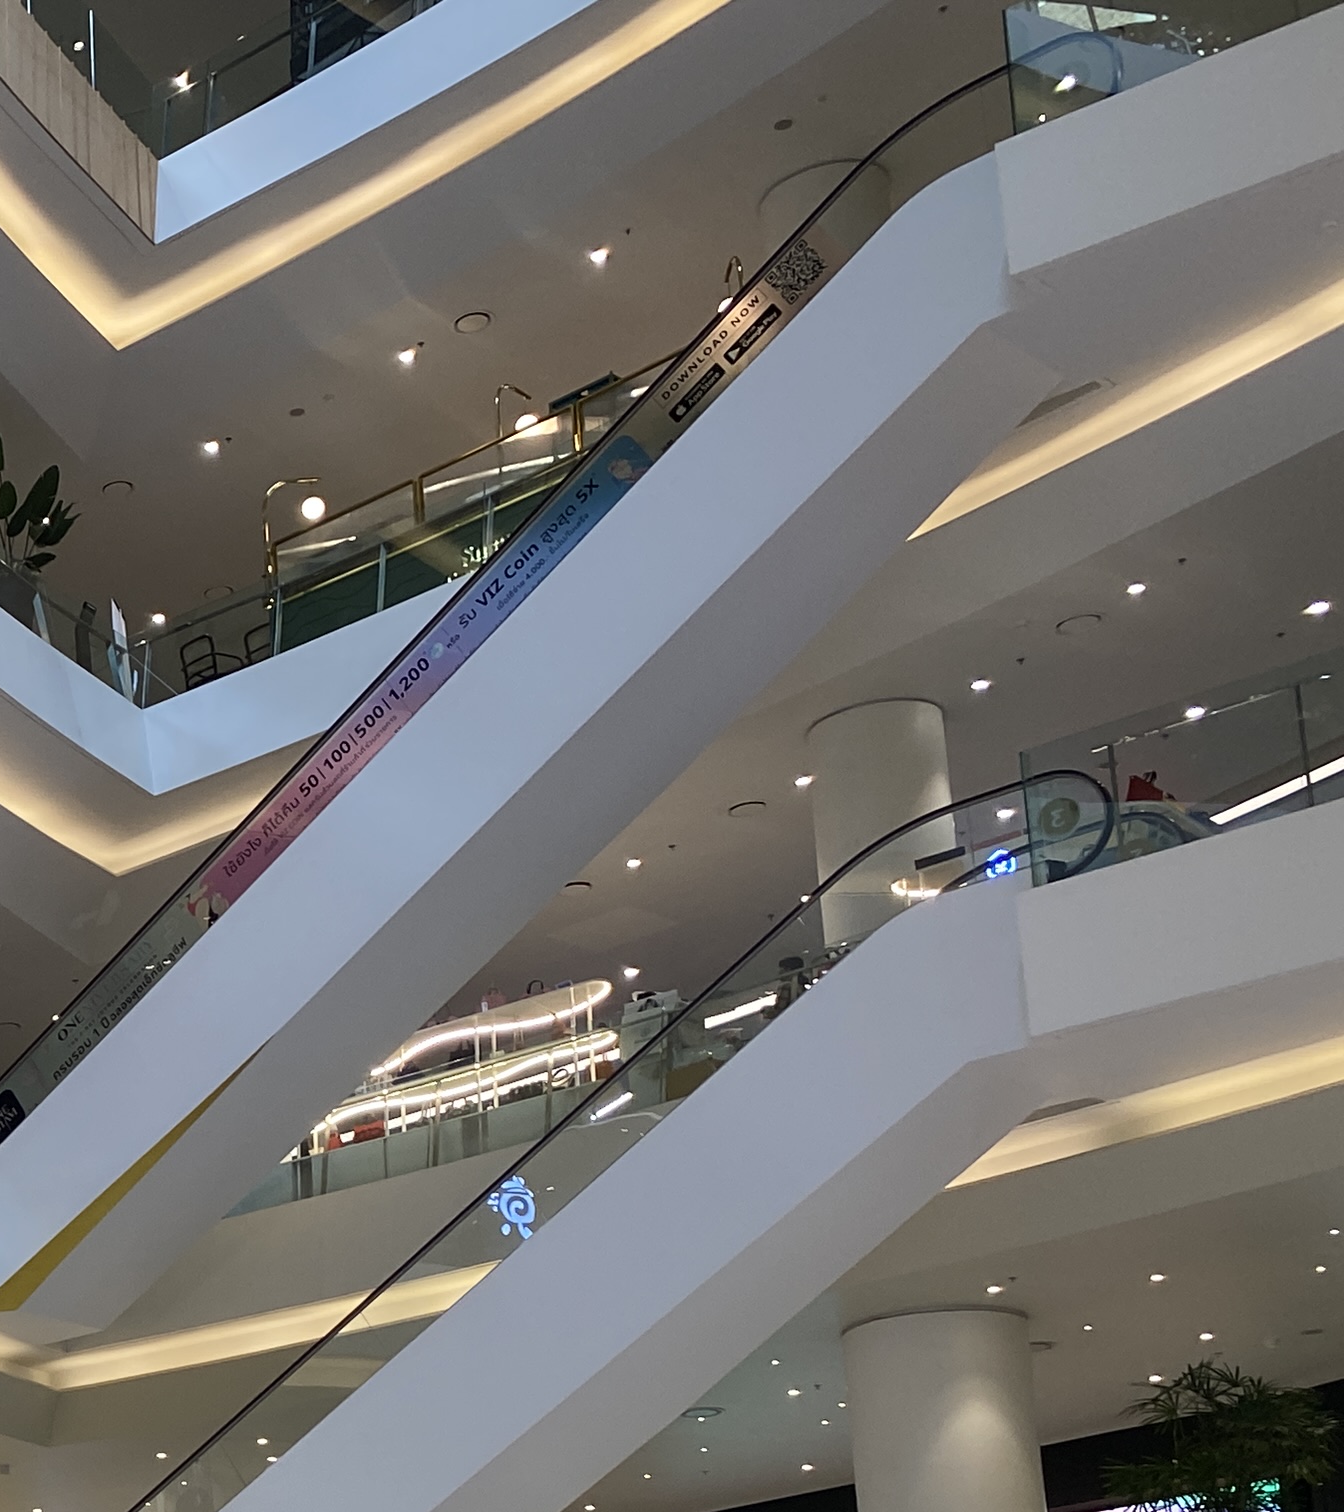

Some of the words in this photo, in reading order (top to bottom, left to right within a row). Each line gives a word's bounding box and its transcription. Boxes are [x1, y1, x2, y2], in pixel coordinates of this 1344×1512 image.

[663, 330, 727, 398] DOWNLOAD
[731, 296, 759, 326] NOW
[476, 579, 504, 607] VIZ
[502, 542, 538, 579] Coin
[539, 504, 578, 544] สูงสุด
[575, 479, 598, 503] 5X
[51, 1037, 91, 1079] ครบรอบ
